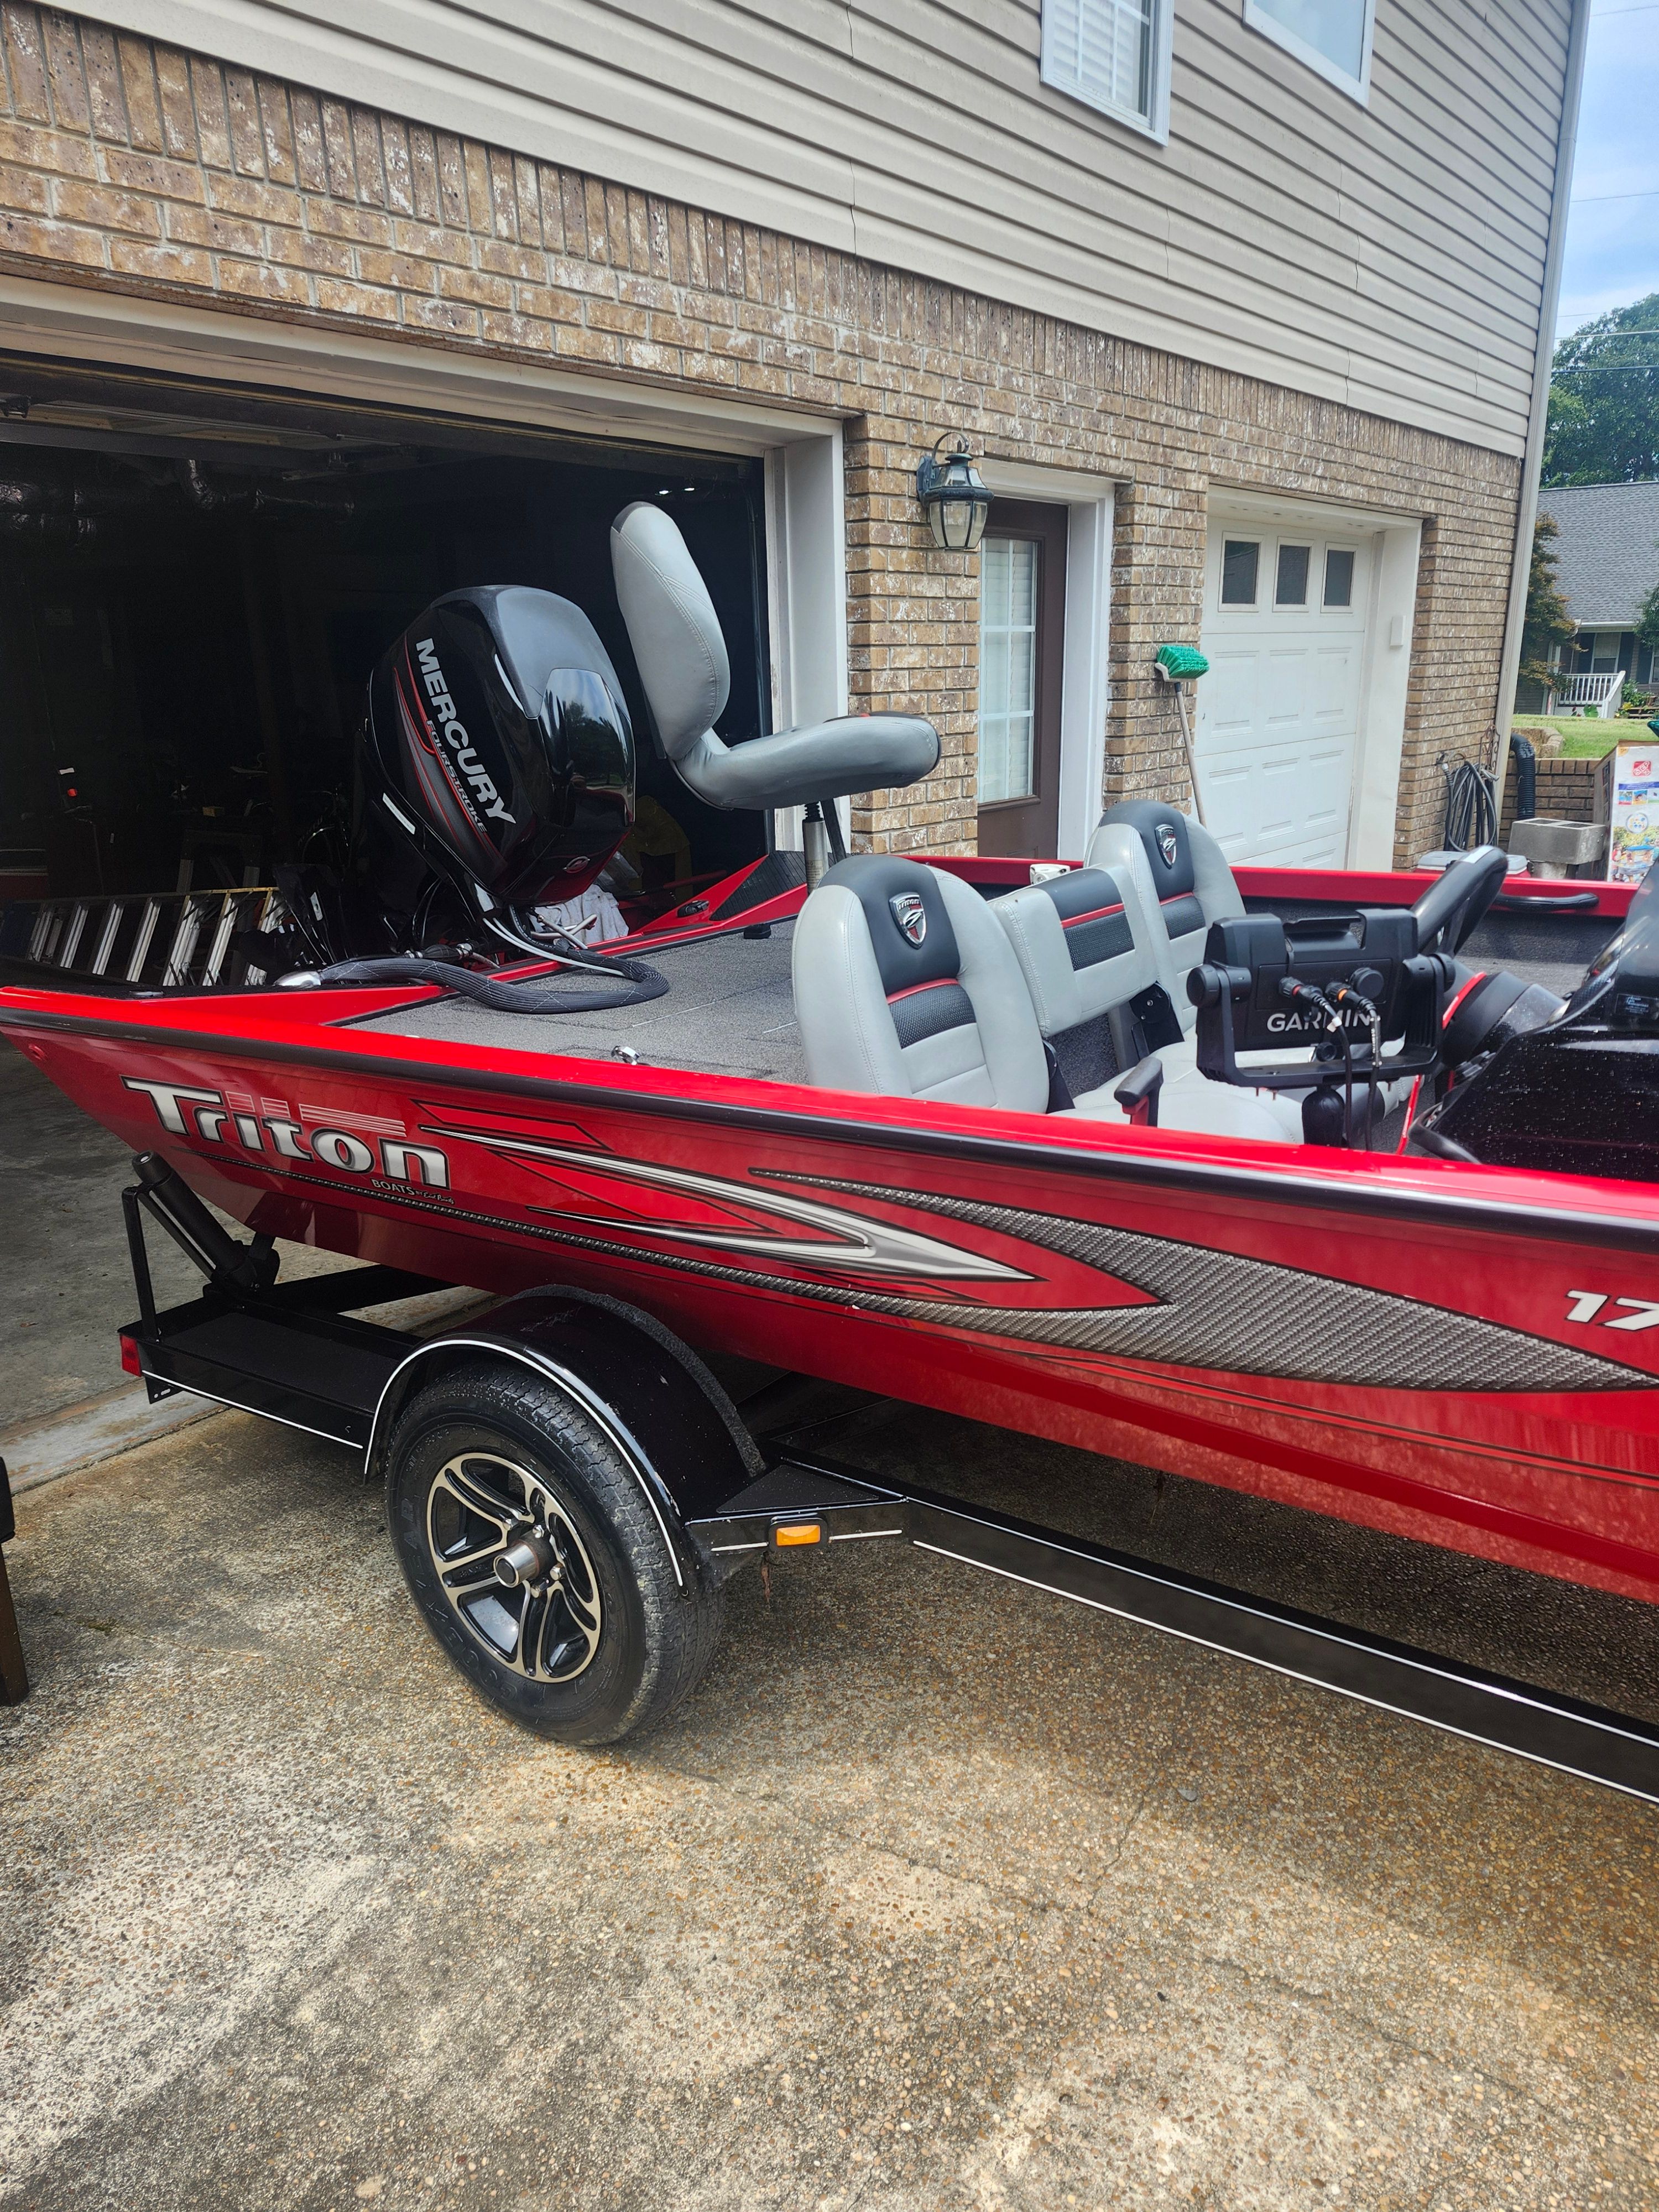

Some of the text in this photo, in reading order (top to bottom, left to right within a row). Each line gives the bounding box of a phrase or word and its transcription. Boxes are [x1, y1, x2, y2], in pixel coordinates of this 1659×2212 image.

[416, 638, 517, 824] MERCURY
[426, 720, 487, 832] FOURSTROKE
[1634, 761, 1650, 775] STEP
[120, 1075, 451, 1190] Triton
[371, 1178, 415, 1196] BOATS
